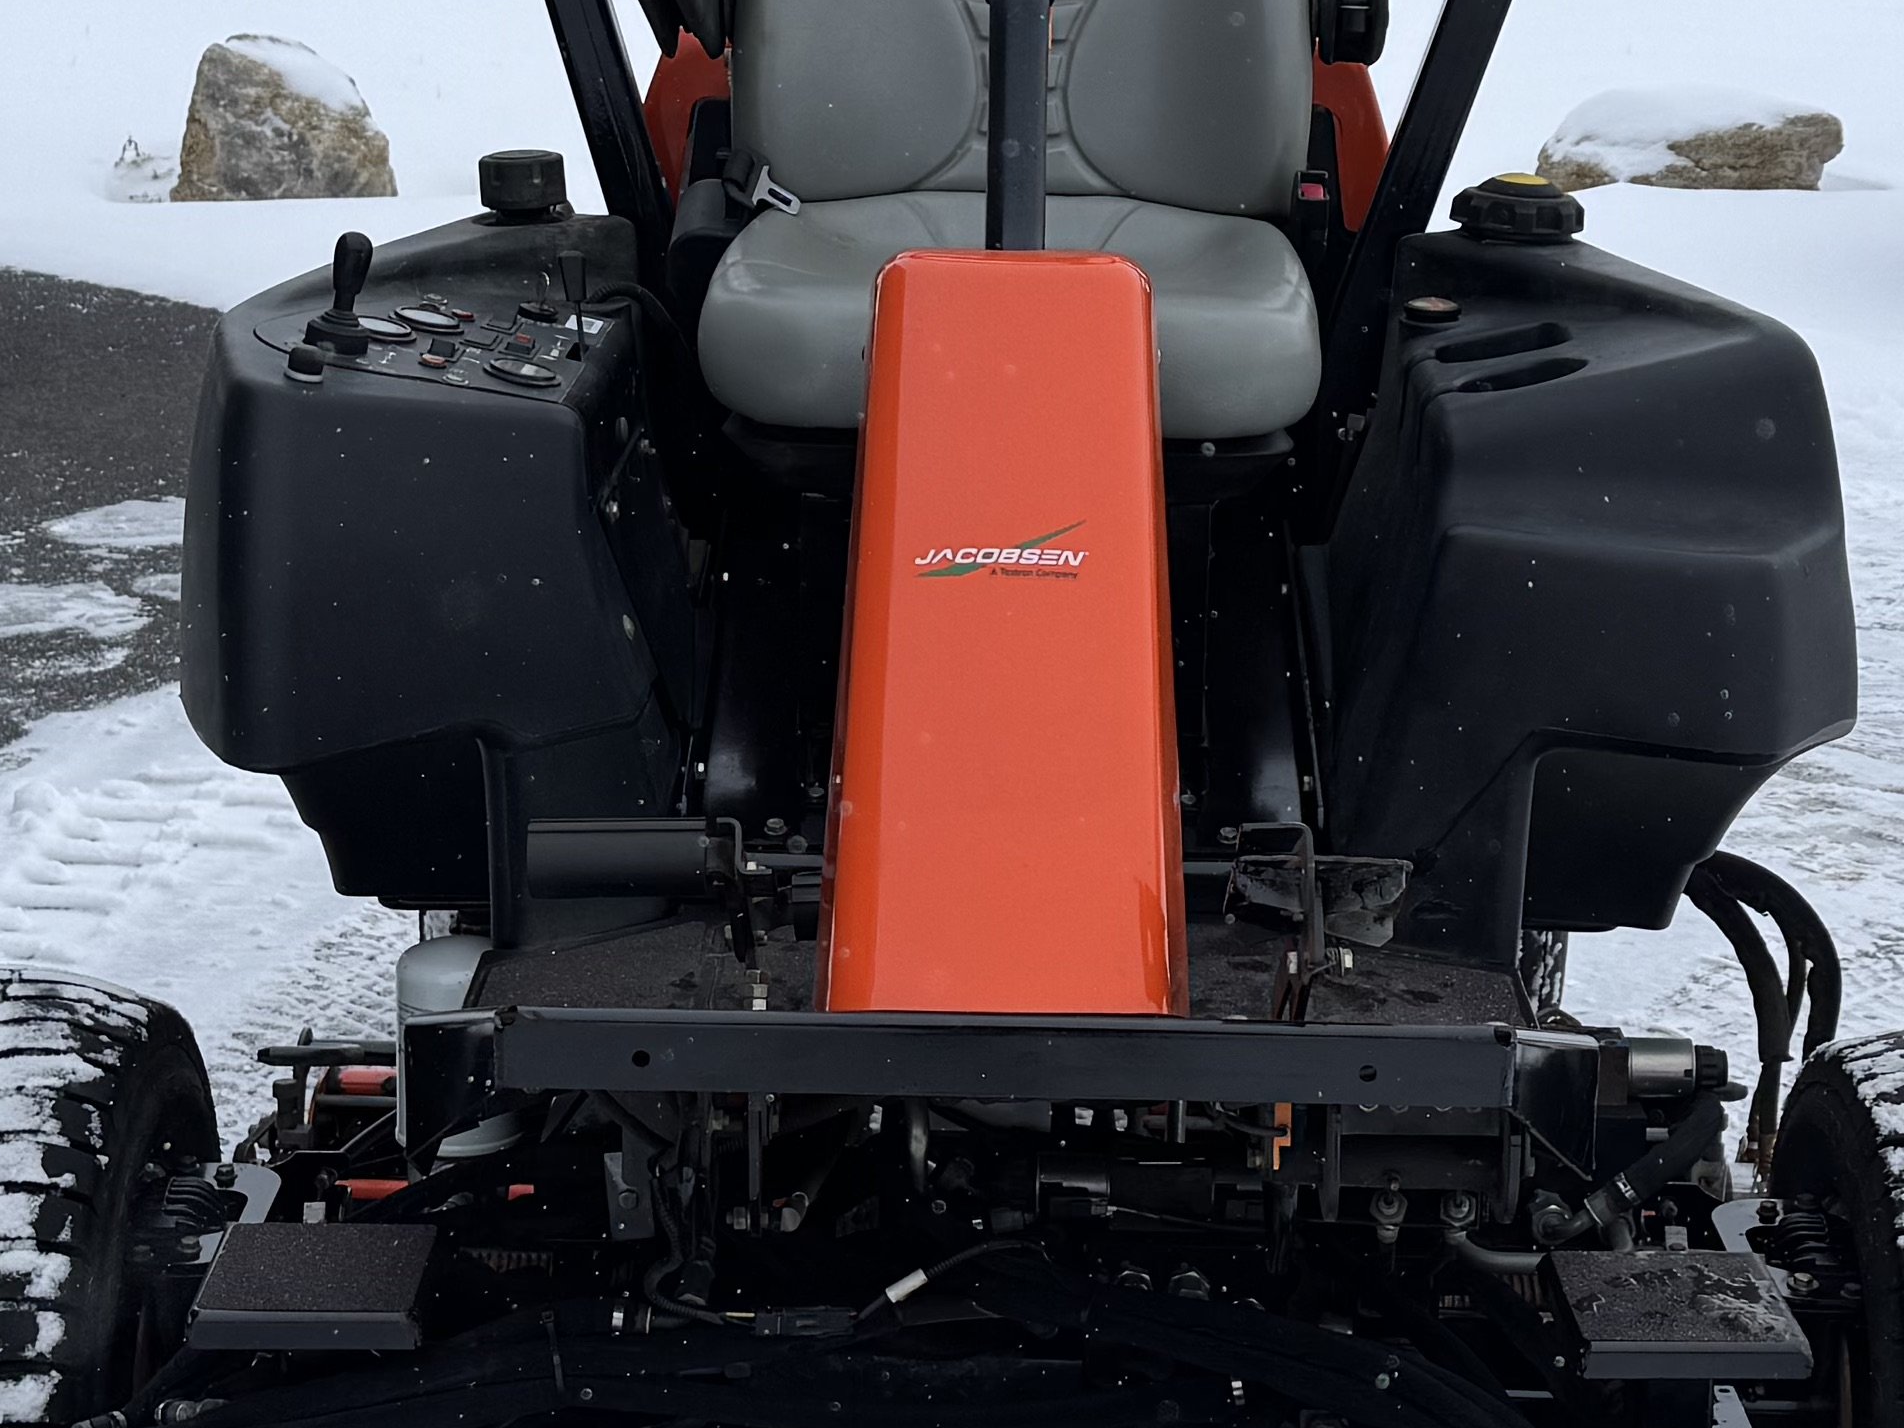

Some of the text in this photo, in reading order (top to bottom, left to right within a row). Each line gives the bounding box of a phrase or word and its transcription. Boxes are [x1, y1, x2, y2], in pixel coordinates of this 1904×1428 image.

[914, 547, 1086, 567] JACOBSEN
[1000, 567, 1034, 577] Textron
[1036, 568, 1078, 579] Company
